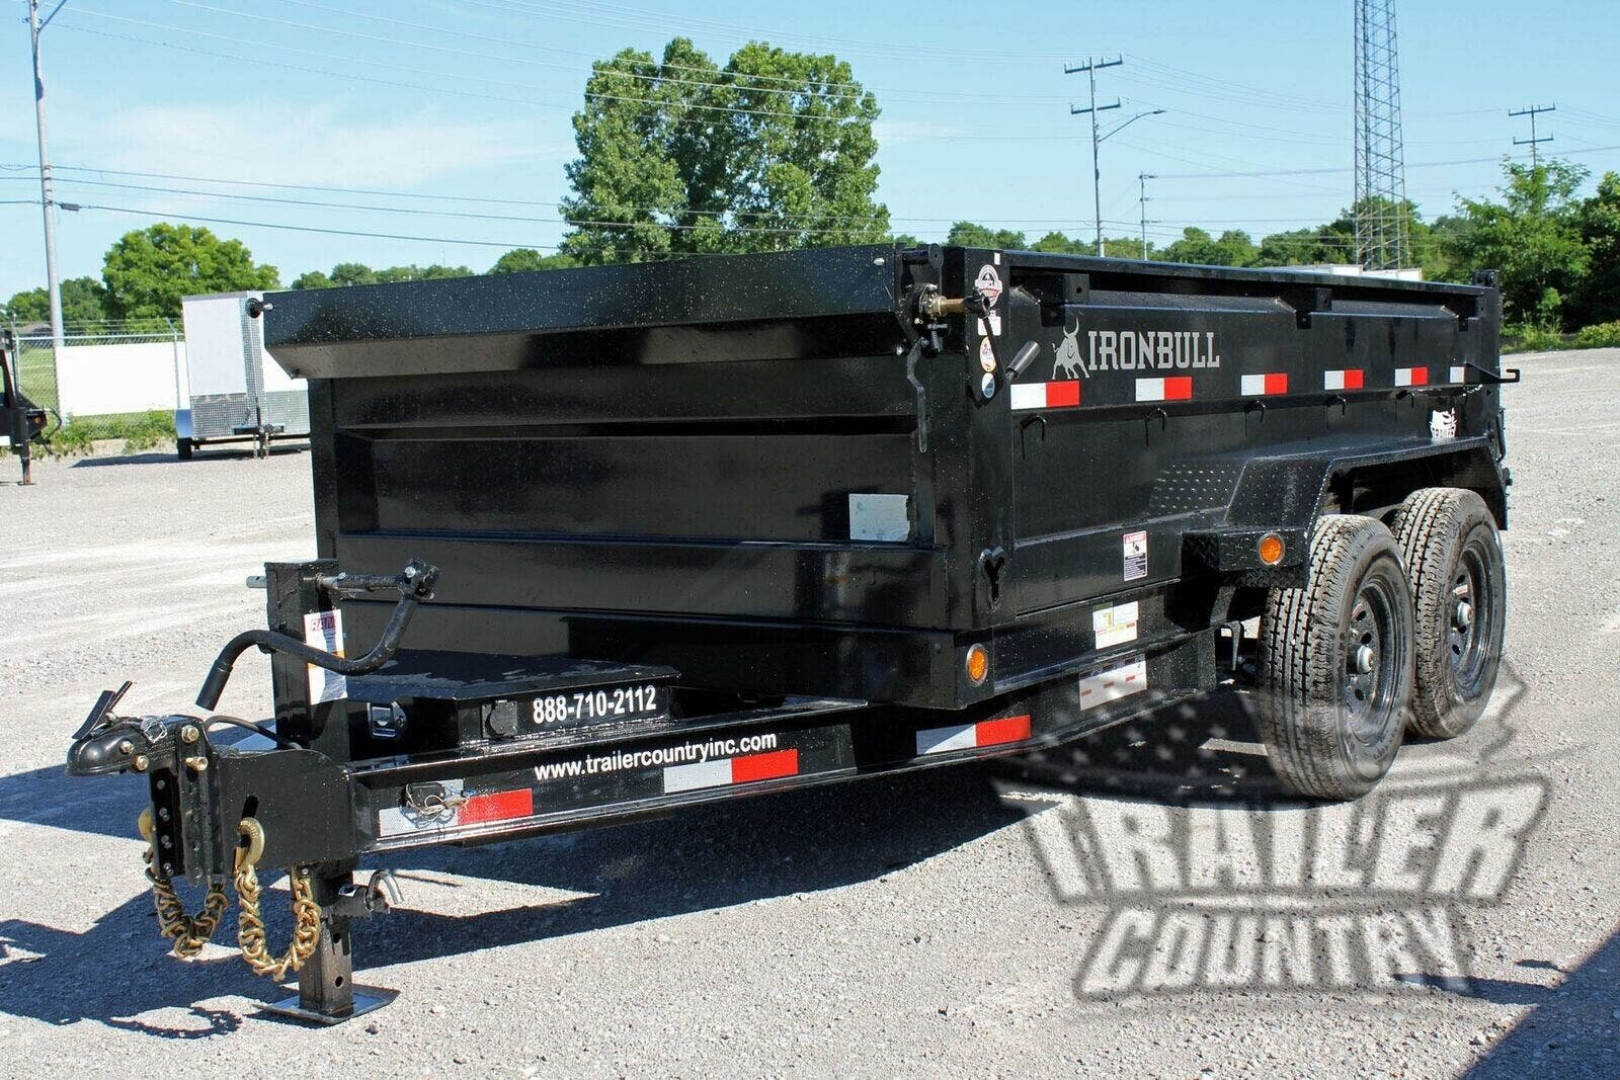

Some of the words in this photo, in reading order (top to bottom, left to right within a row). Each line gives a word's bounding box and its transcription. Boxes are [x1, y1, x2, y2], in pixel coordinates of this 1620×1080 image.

[1088, 331, 1220, 371] IRONBULL
[533, 685, 657, 724] 888-710-2112
[534, 733, 777, 781] www.trailercountryinc.com
